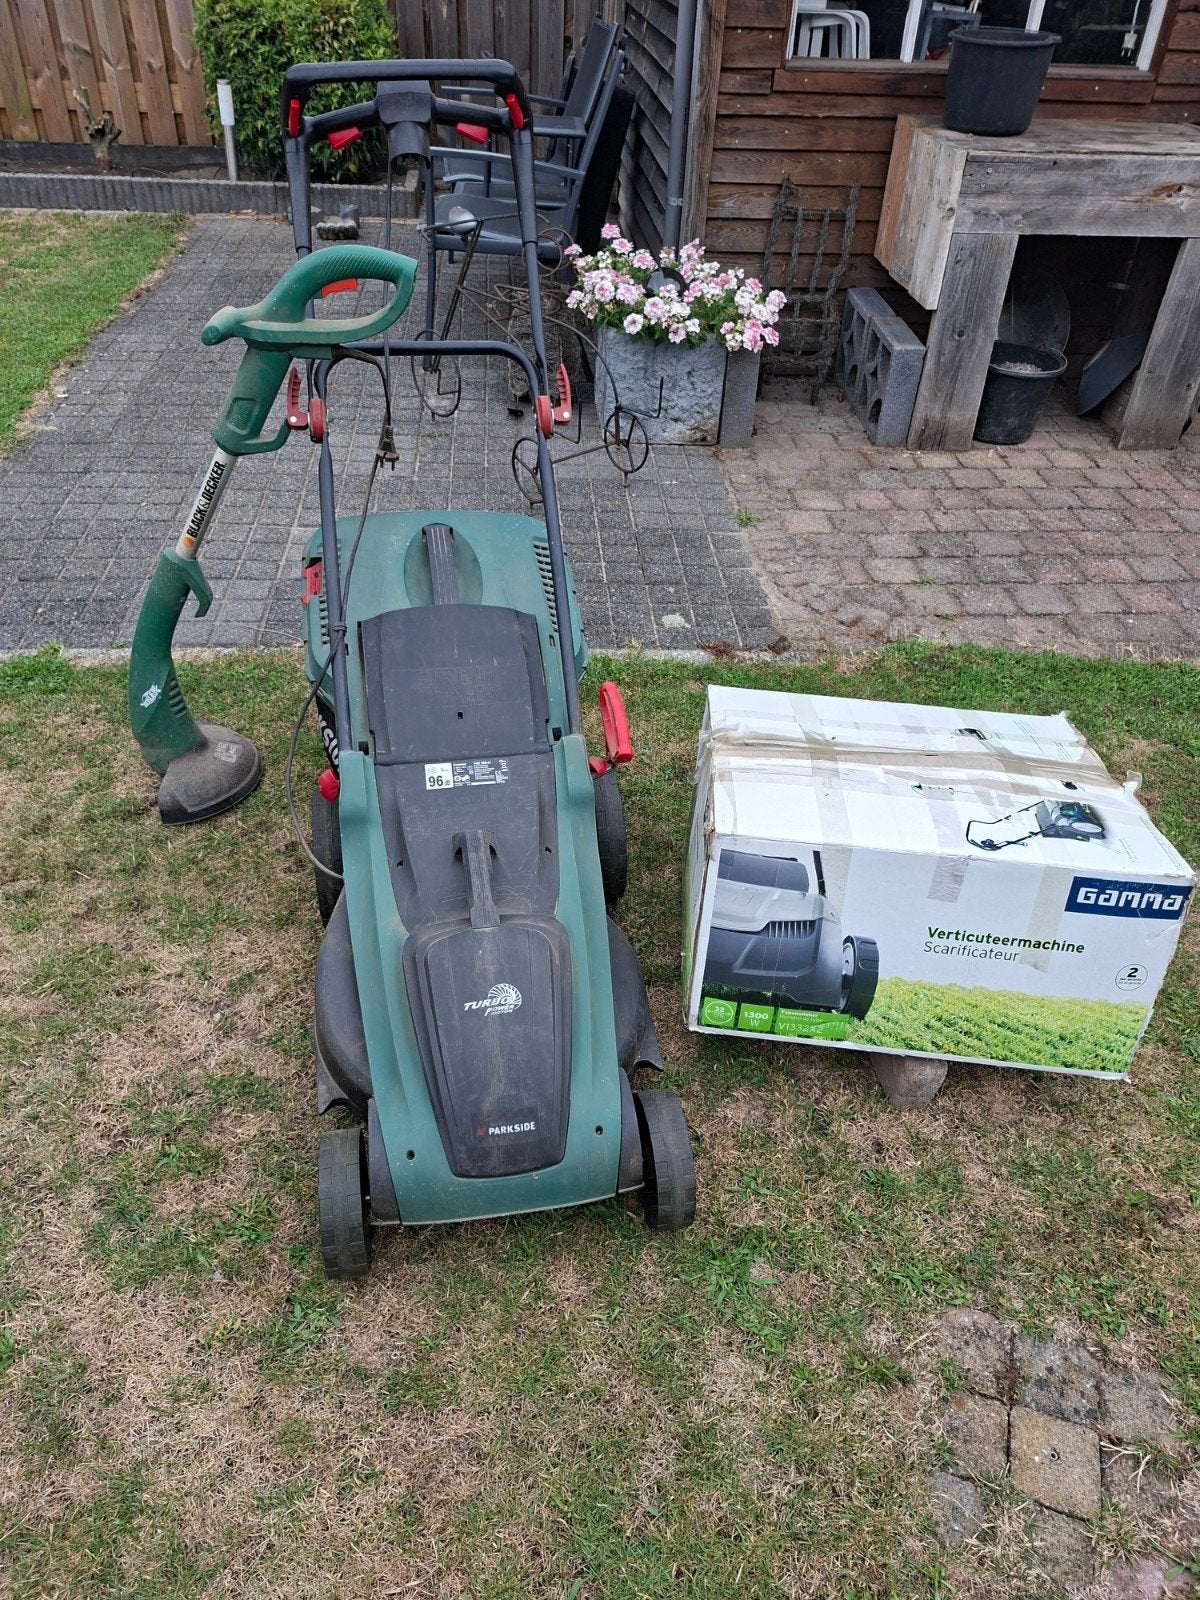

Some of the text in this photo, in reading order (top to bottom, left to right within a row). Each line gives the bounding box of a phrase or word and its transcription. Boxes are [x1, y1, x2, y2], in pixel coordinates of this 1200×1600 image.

[186, 460, 227, 539] BLACK&DECKER
[428, 775, 443, 788] 96
[927, 926, 1085, 954] Verticuteermachine
[923, 941, 1020, 962] Scarificateur
[1127, 967, 1138, 978] 2
[464, 997, 510, 1011] TURBO
[744, 1011, 769, 1020] 1300
[750, 1019, 760, 1027] W
[488, 1122, 536, 1135] PARKSIDE
